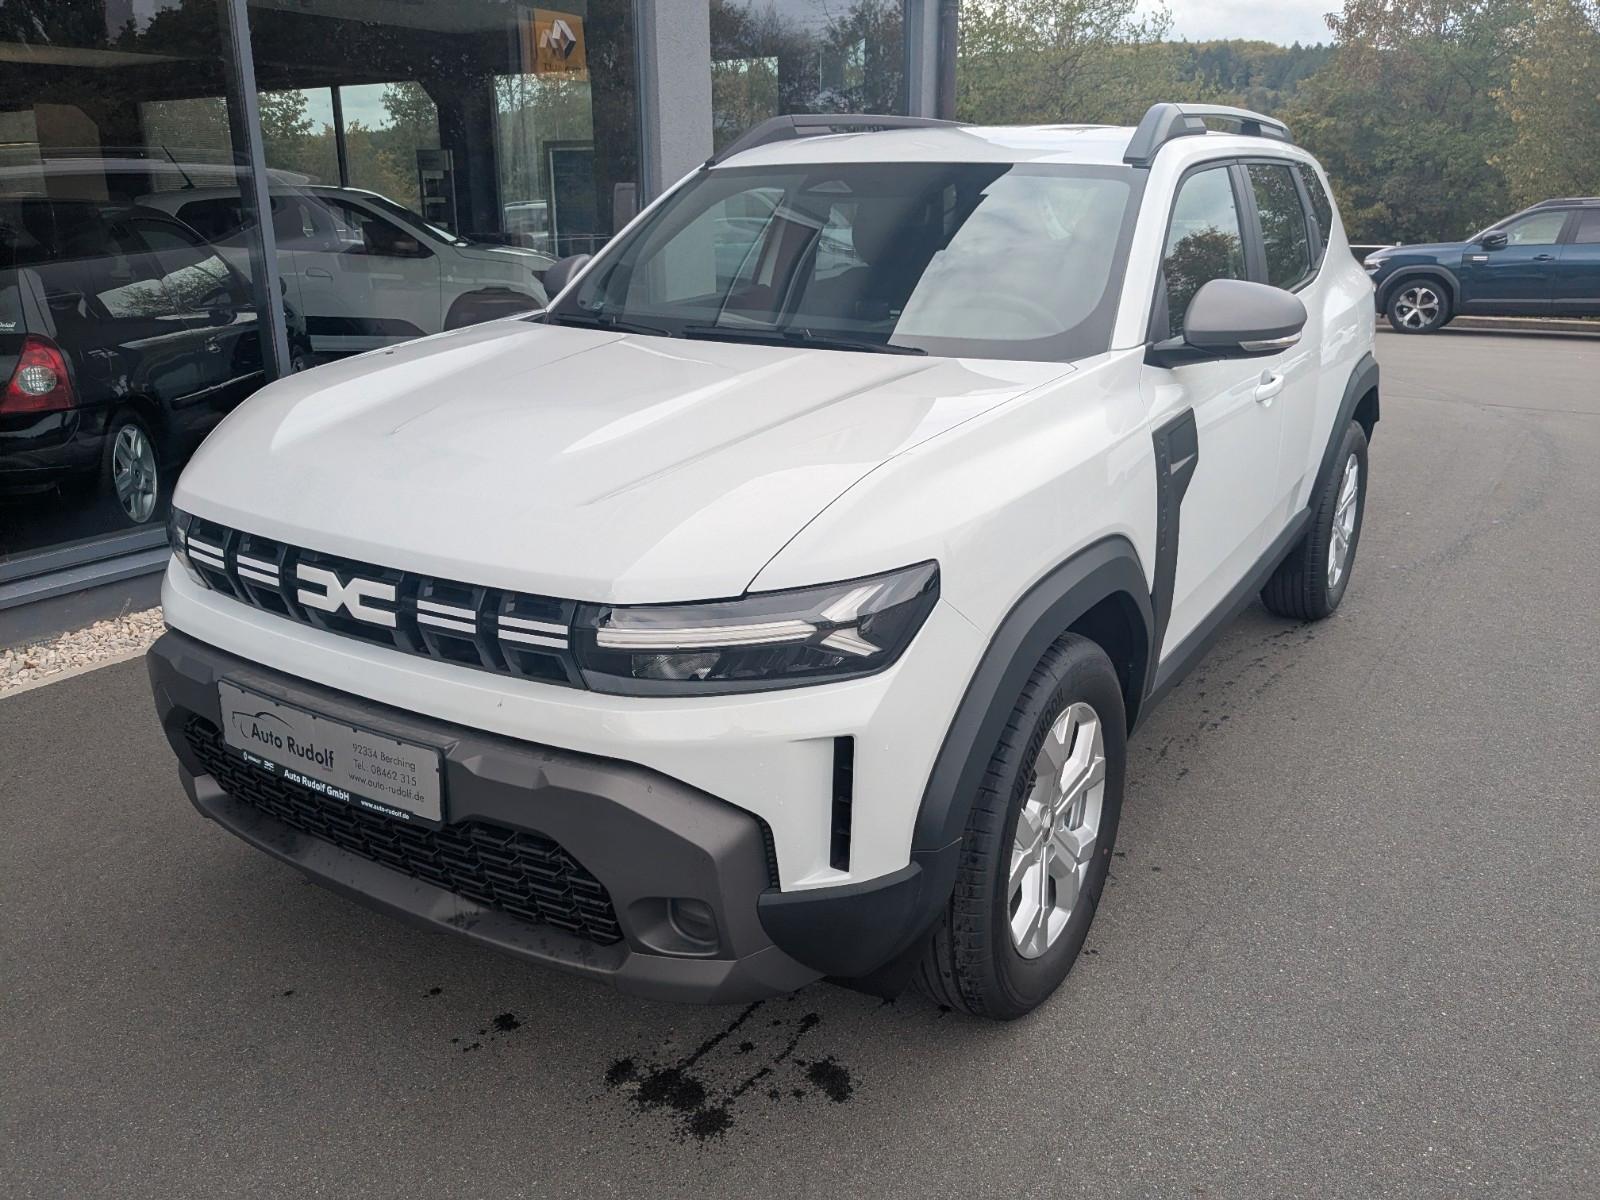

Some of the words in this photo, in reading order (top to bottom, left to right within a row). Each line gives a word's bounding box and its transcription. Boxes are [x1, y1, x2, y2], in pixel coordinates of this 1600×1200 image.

[251, 723, 283, 749] Auto
[287, 736, 334, 769] Rudolf
[352, 743, 378, 759] 92334
[380, 751, 416, 773] Berching
[284, 769, 301, 783] Auto
[302, 776, 326, 793] Rudolf
[326, 786, 350, 802] GmbH
[348, 772, 425, 803] www.auto-rudolf.de
[371, 764, 398, 781] 08462
[400, 774, 417, 787] 315
